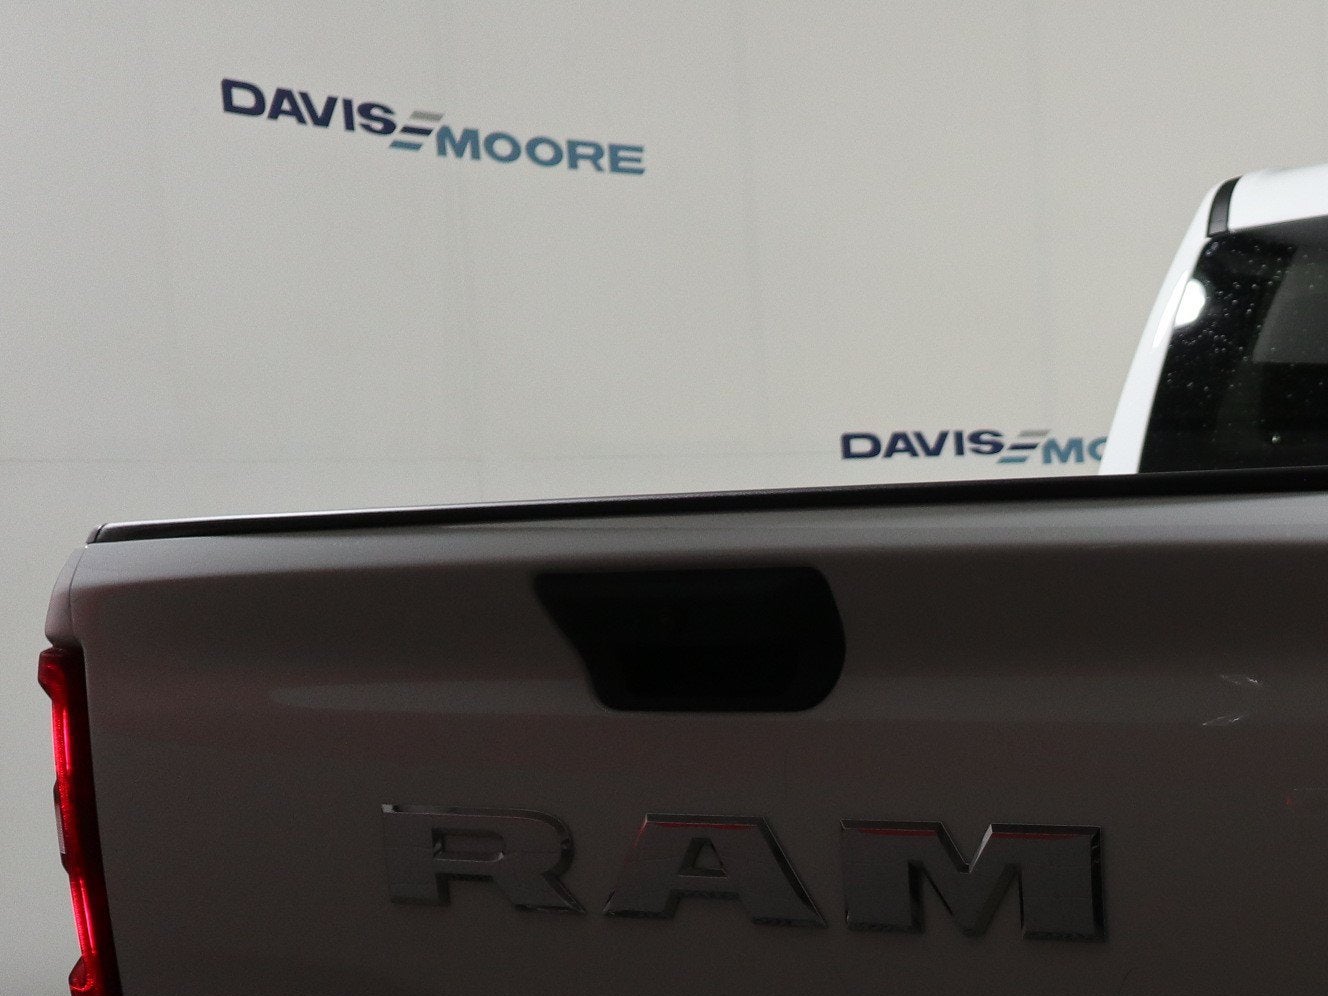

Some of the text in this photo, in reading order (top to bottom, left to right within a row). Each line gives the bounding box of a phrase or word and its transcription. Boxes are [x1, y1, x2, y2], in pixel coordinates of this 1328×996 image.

[220, 77, 646, 175] DAVIS MOORE
[841, 430, 1005, 459] DAVIS
[380, 803, 1107, 942] RAM
